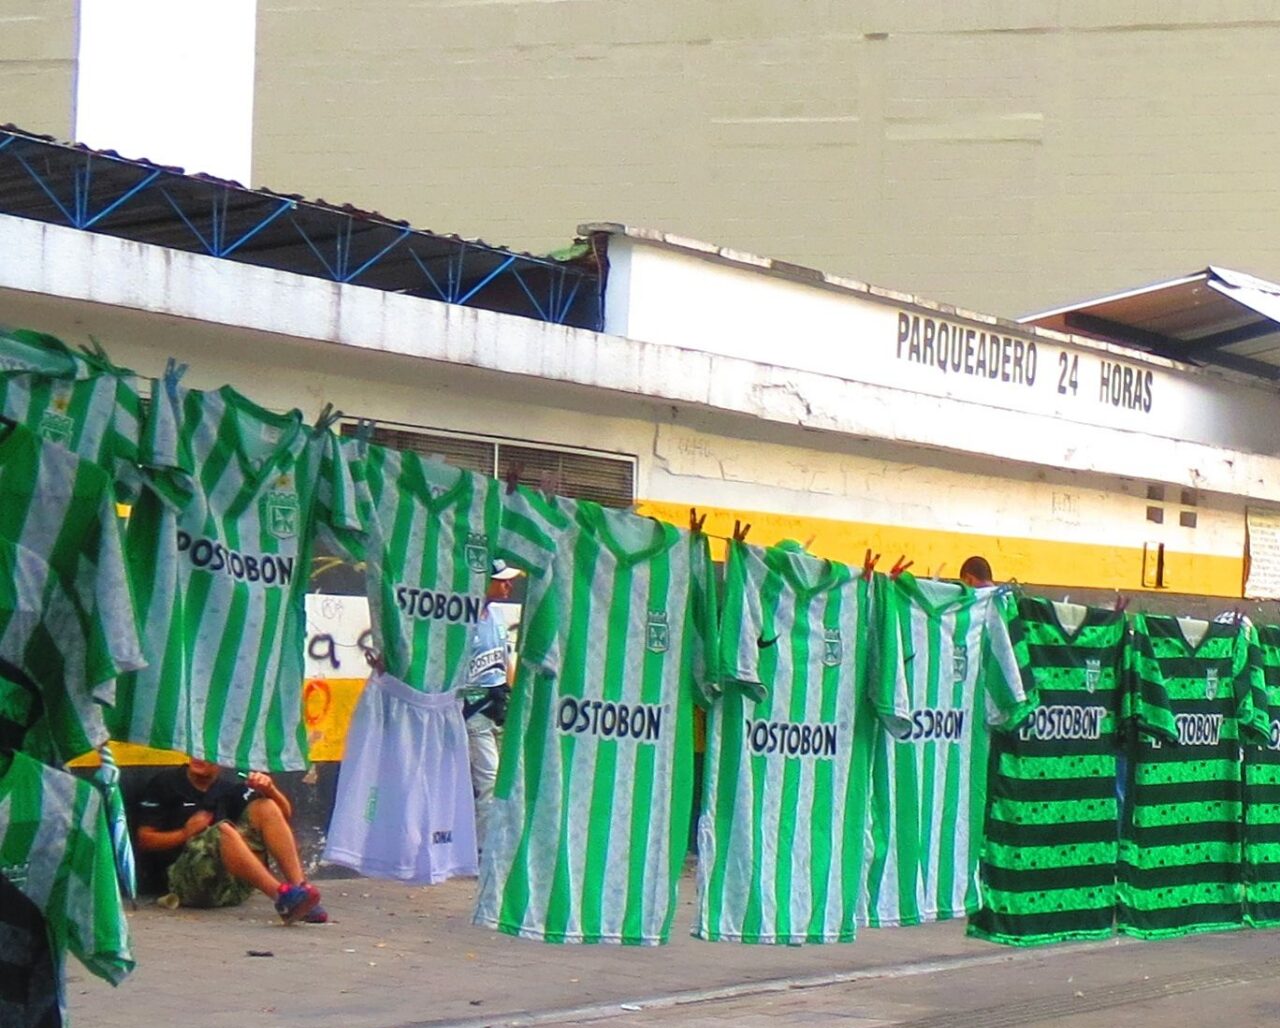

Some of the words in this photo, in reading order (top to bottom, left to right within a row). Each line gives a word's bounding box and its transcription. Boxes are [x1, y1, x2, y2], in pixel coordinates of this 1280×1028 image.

[896, 311, 1038, 387] PARQUEADERO
[1057, 351, 1079, 397] 24
[1099, 360, 1154, 414] HORAS
[556, 697, 662, 740] OSTOBON
